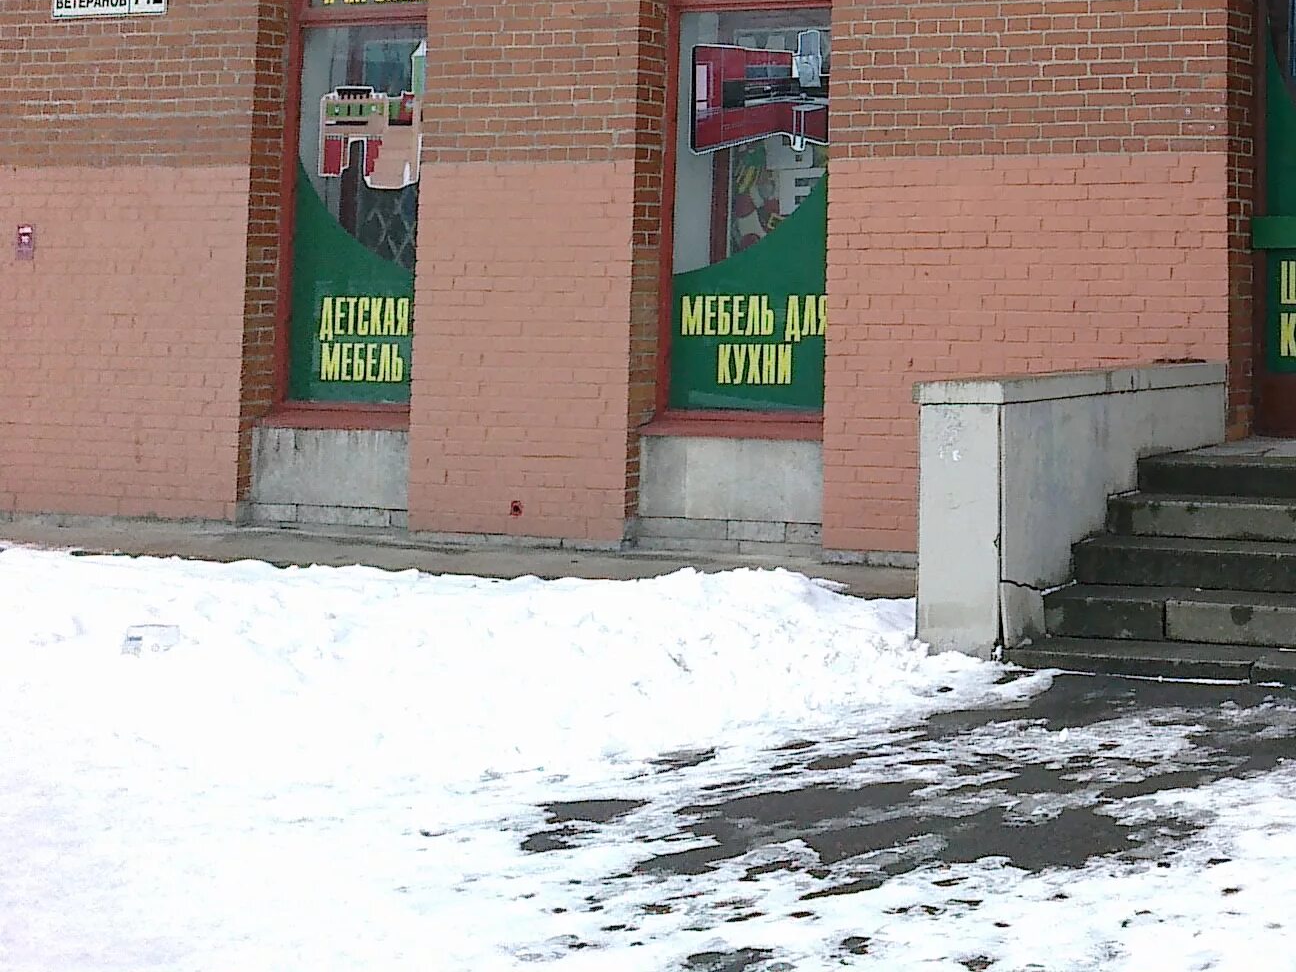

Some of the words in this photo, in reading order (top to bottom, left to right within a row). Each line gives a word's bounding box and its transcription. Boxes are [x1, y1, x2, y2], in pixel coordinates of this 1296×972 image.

[319, 296, 410, 341] ДЕТСКАЯ
[681, 294, 775, 336] МЕБЕЛЬ
[784, 294, 828, 343] ДЛЯ
[320, 342, 404, 382] МЕБЕЛЬ
[717, 343, 793, 385] КУХНИ
